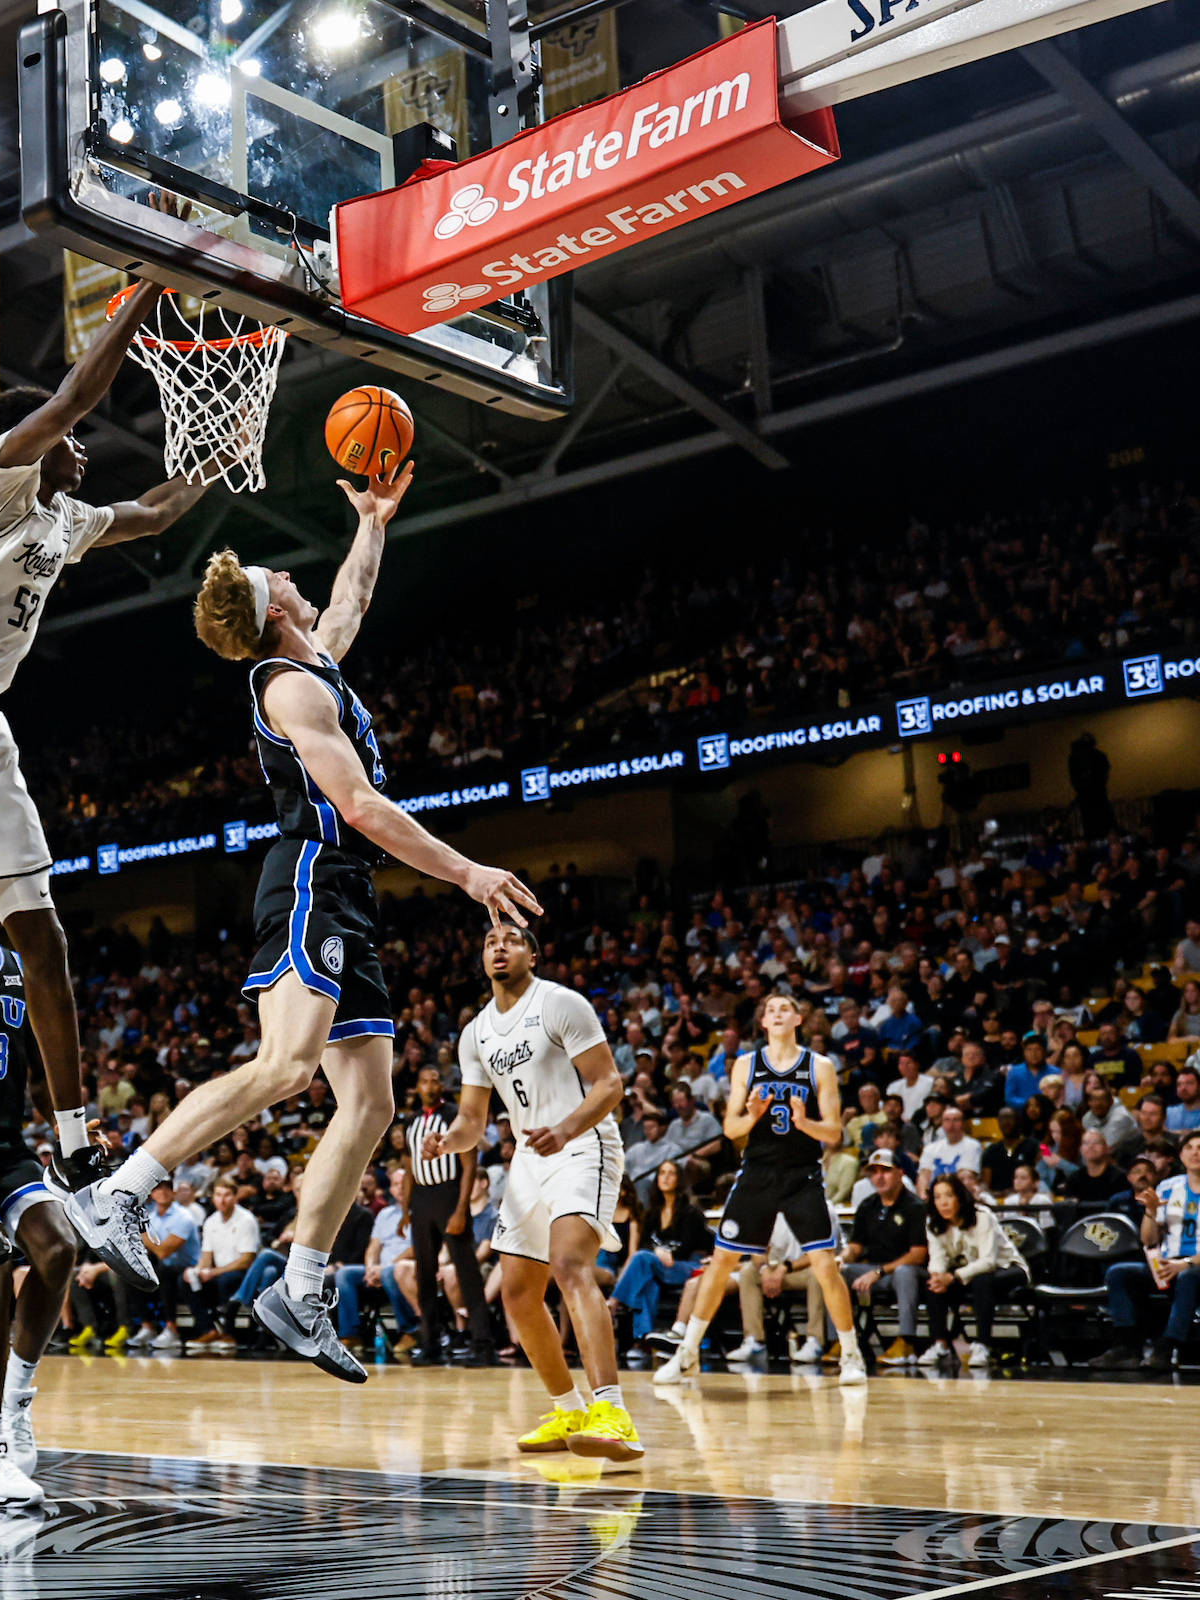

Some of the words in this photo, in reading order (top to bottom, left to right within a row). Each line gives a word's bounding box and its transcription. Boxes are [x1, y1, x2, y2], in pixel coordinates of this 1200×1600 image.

[7, 585, 41, 633] 52
[932, 690, 1019, 721] ROOFING
[1021, 688, 1036, 705] &
[1036, 675, 1105, 703] SOLAR
[730, 727, 807, 757] ROOFING
[808, 726, 821, 743] &
[821, 714, 882, 741] SOLAR
[549, 762, 618, 788] ROOFING
[619, 760, 631, 777] &
[631, 749, 686, 775] SOLAR
[461, 782, 510, 803] SOLAR
[120, 842, 168, 863] ROOFING
[177, 833, 217, 853] SOLAR
[487, 1040, 536, 1076] Knights
[512, 1079, 529, 1108] 6
[770, 1104, 790, 1135] 3
